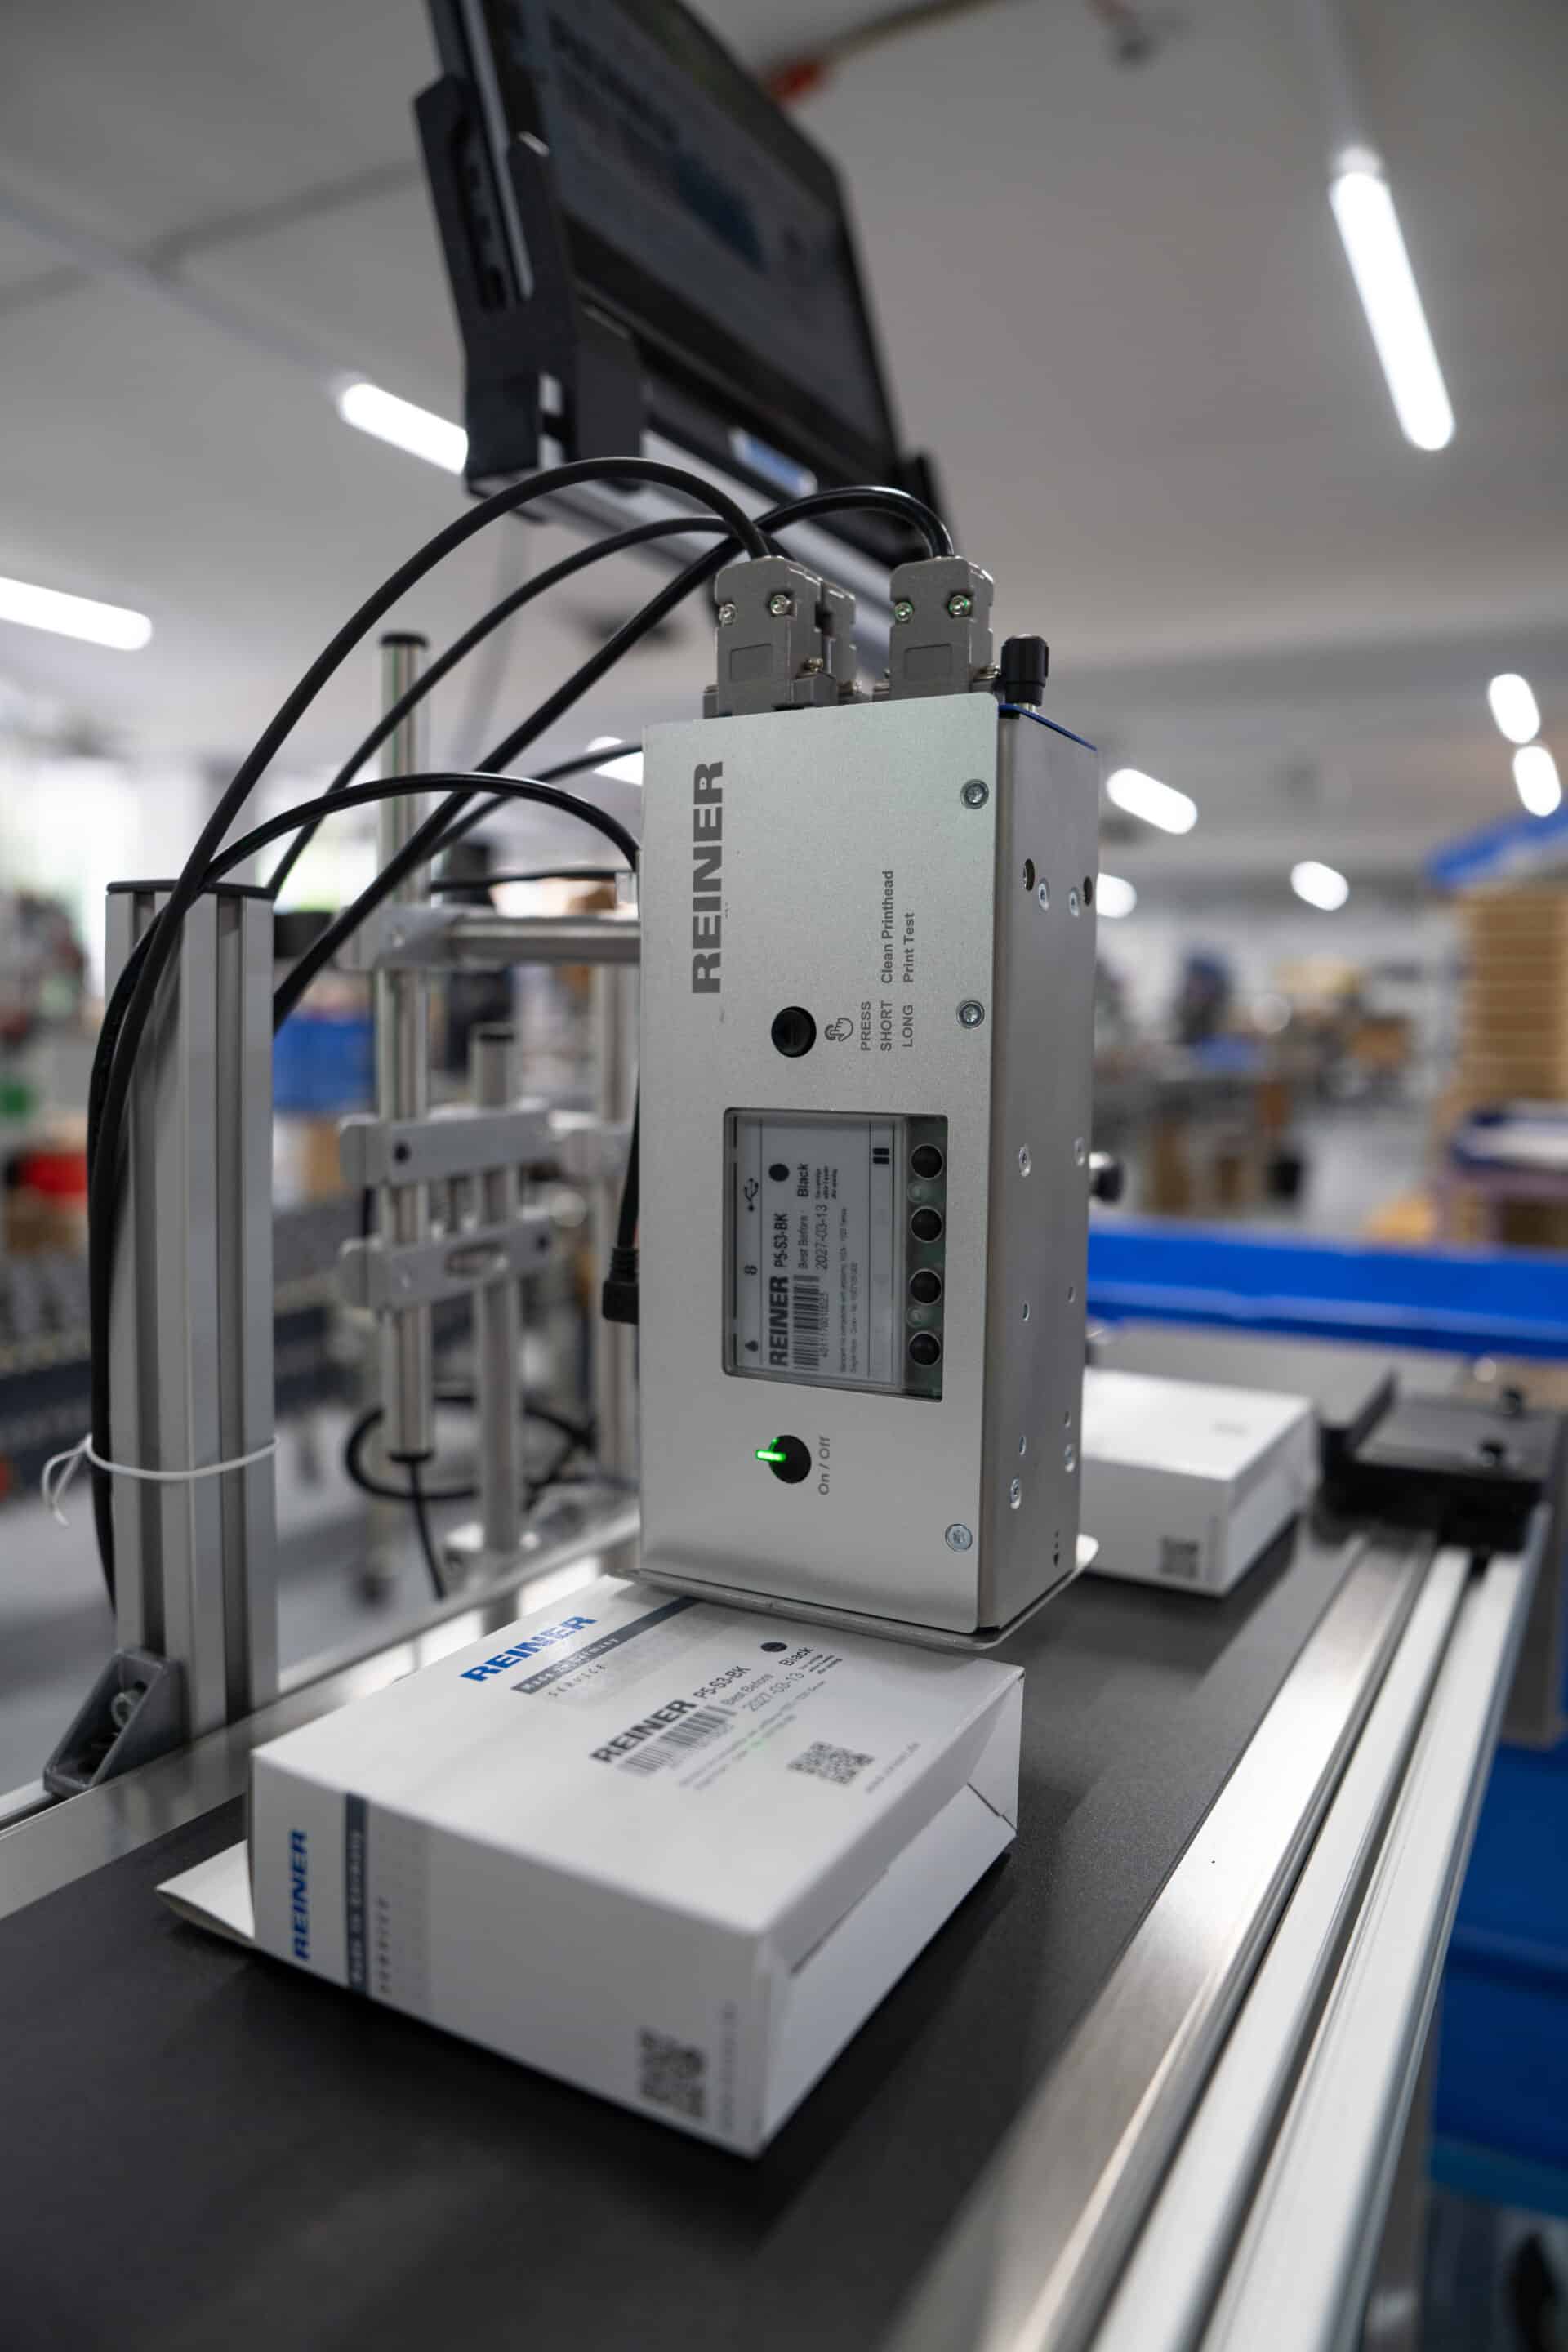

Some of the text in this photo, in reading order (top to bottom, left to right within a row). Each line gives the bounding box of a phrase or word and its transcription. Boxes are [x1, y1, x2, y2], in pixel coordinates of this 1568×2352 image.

[693, 761, 723, 993] REINER
[880, 871, 894, 1052] SHORT Clean Printhead
[902, 912, 915, 1048] LONG Print Test
[860, 1000, 871, 1051] PRESS
[796, 1163, 809, 1197] Black
[815, 1204, 828, 1270] 2027-03-13
[769, 1214, 789, 1367] REINER P5-S3-BK
[818, 1436, 831, 1460] Off
[818, 1473, 831, 1495] On
[459, 1615, 599, 1682] REINER
[779, 1646, 815, 1667] Black
[590, 1699, 698, 1763] REINER
[693, 1664, 752, 1699] P5-S3-BK
[289, 1829, 310, 1961] REINER
